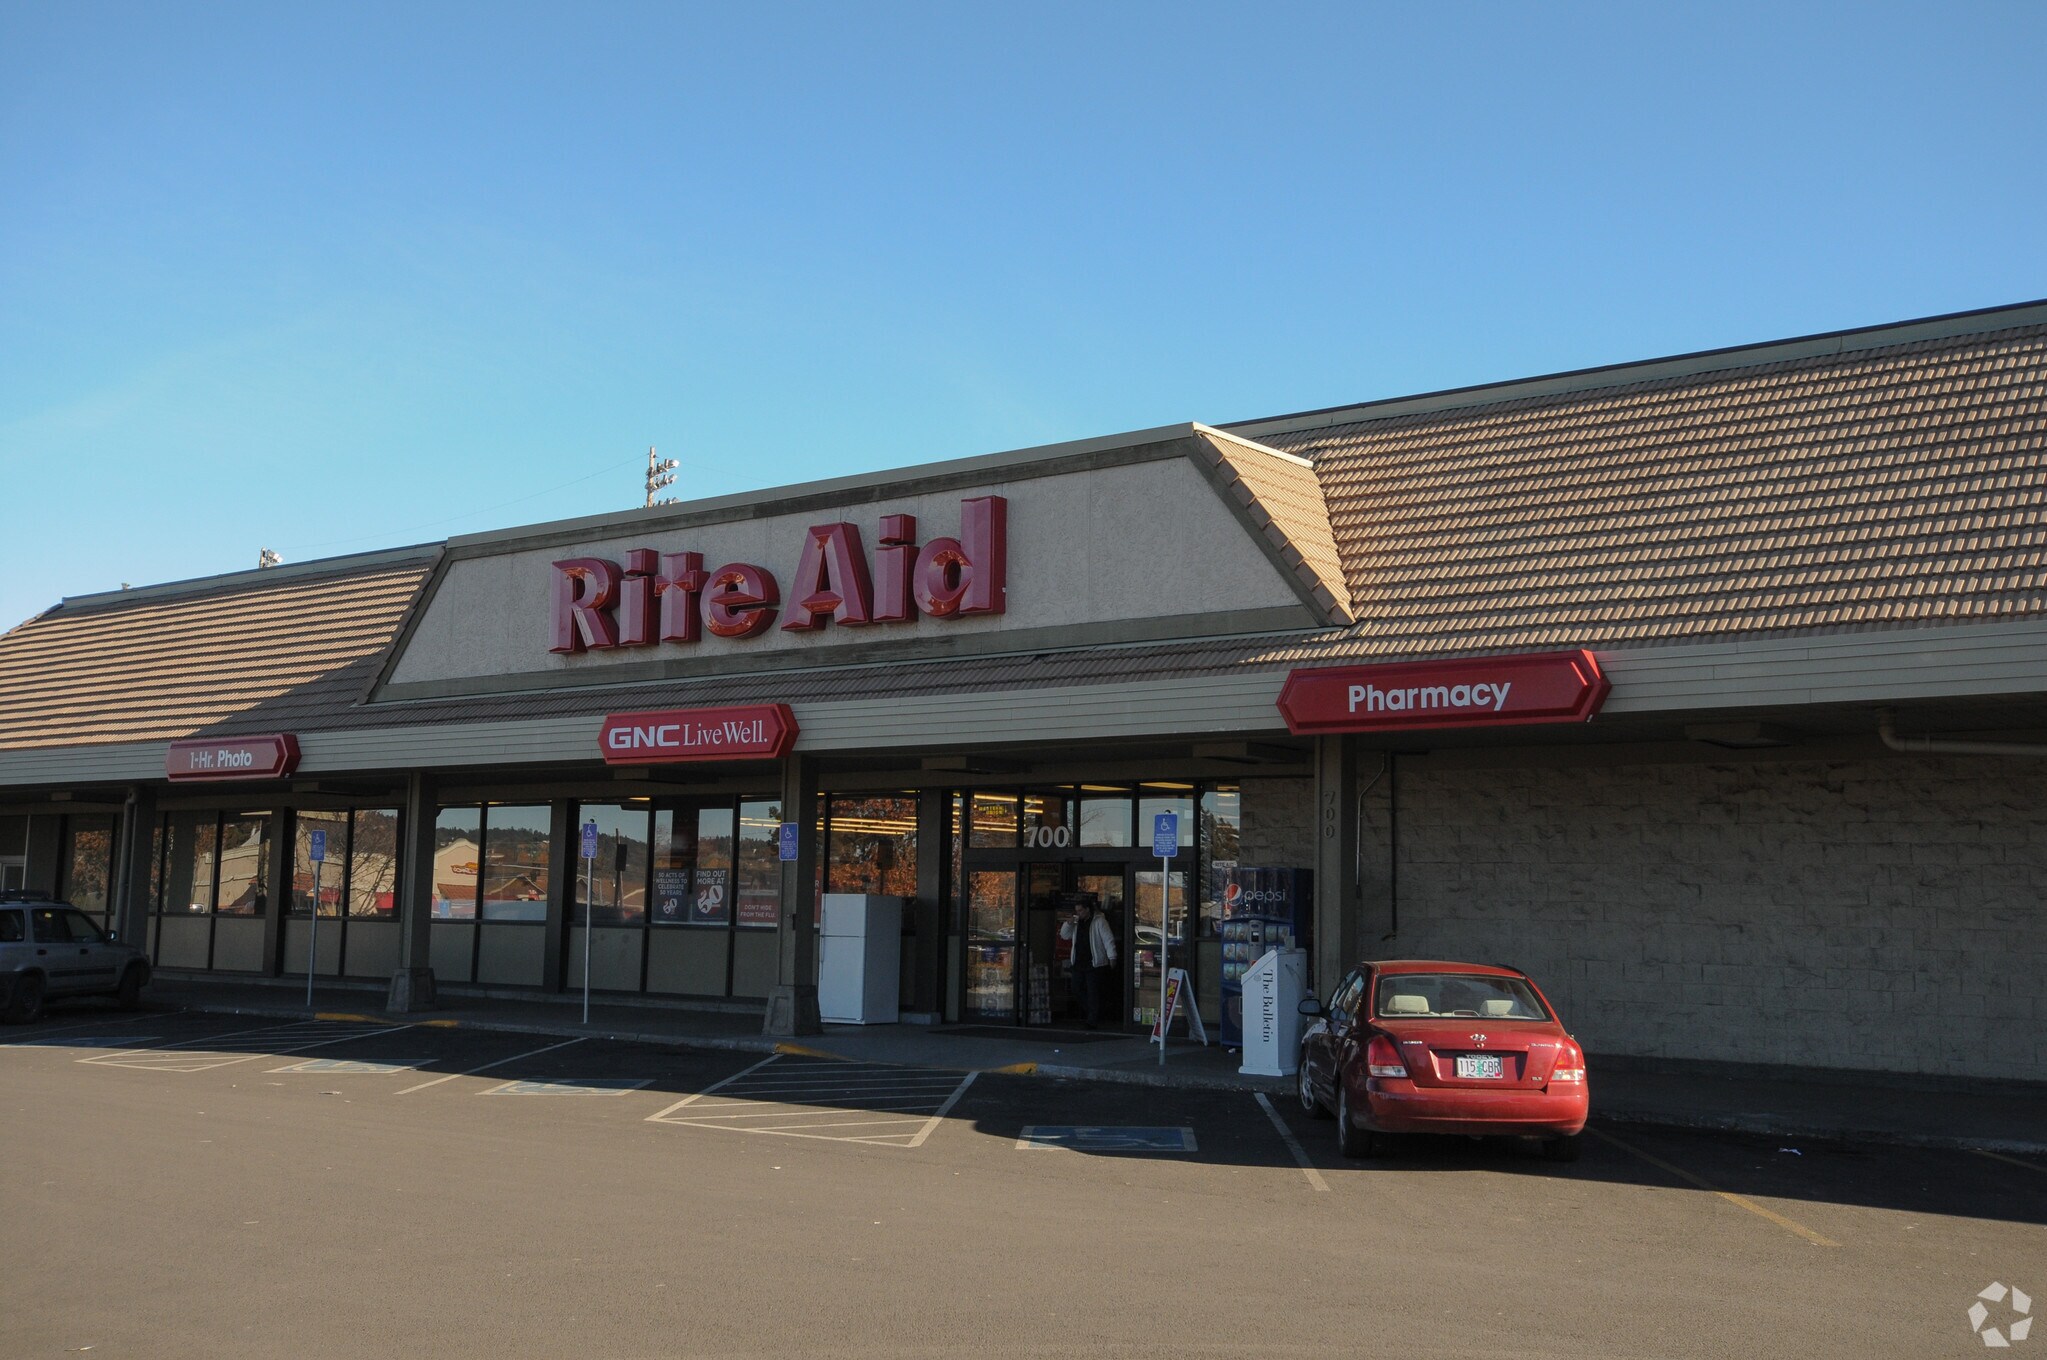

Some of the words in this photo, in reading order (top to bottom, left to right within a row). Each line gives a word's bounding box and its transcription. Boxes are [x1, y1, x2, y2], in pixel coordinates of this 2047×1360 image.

[549, 548, 780, 654] Rite
[781, 495, 1007, 632] Aid
[1348, 682, 1512, 713] Pharmacy
[608, 724, 680, 749] GNC
[190, 751, 214, 769] 1-Hr.
[217, 749, 252, 767] Photo
[1025, 825, 1070, 848] 700
[696, 870, 711, 878] FIND
[1244, 888, 1286, 904] pepsi
[1263, 969, 1273, 993] The
[1263, 996, 1273, 1042] Bulletin
[1459, 1060, 1476, 1073] 115
[1482, 1061, 1501, 1073] CBR
